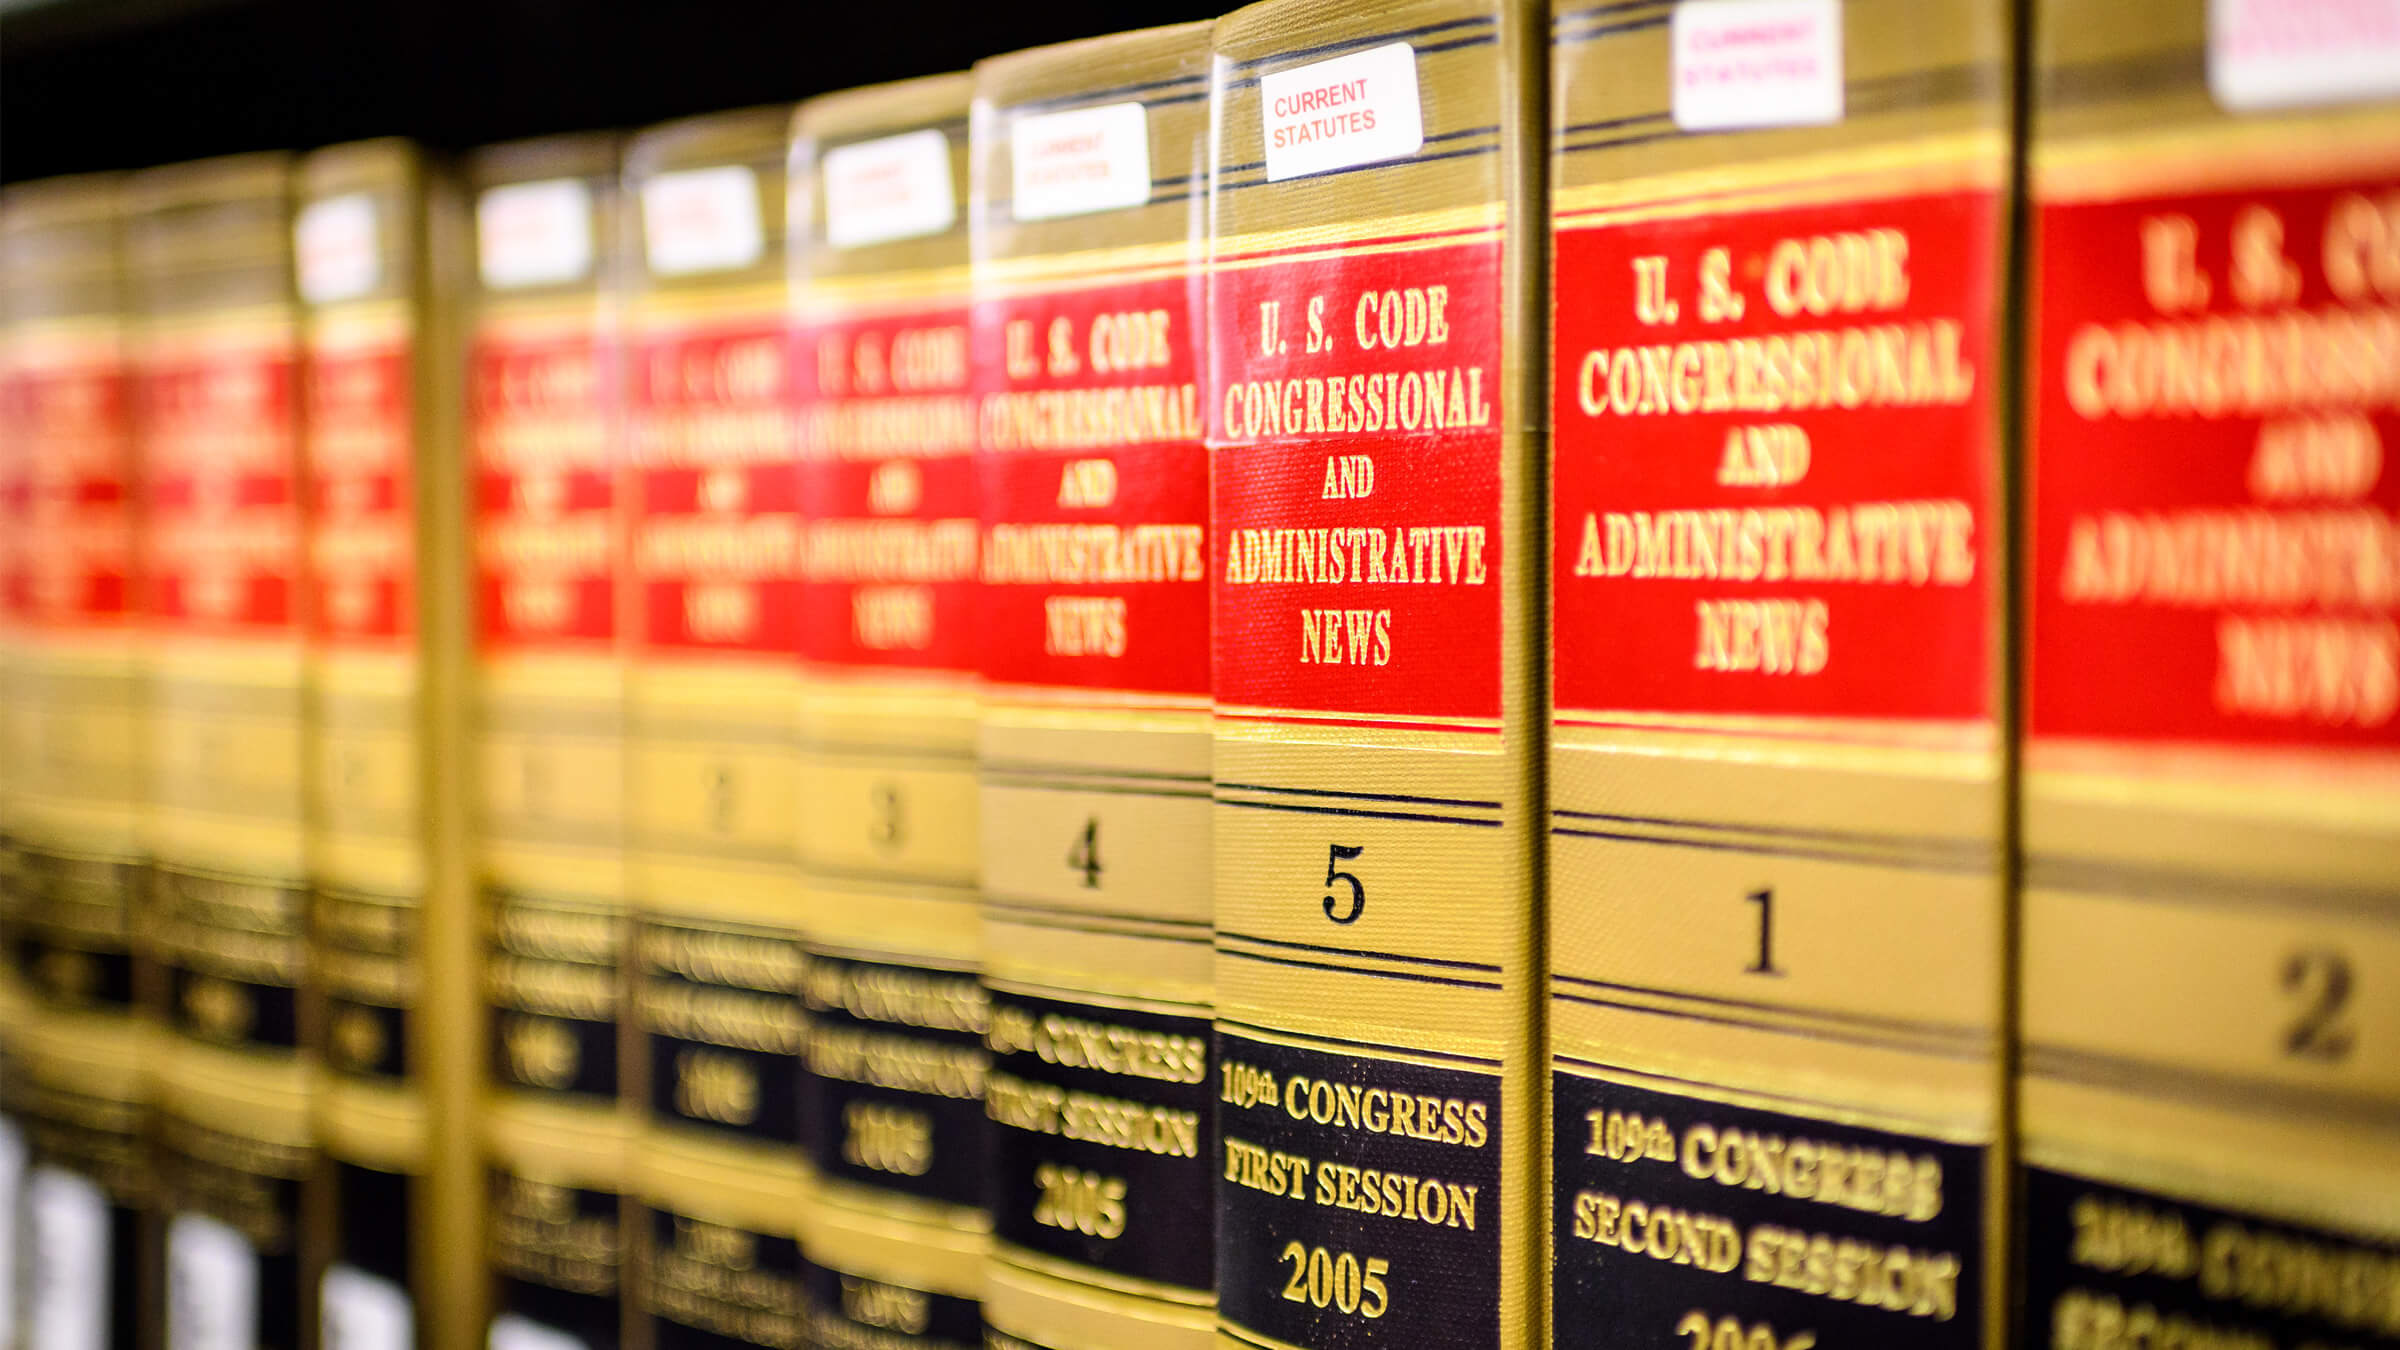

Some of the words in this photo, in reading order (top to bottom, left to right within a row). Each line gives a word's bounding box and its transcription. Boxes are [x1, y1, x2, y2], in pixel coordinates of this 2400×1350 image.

[1273, 109, 1376, 149] STATUTES
[1274, 79, 1368, 118] CURRENT
[1632, 256, 1679, 325] U.
[1697, 246, 1745, 322] S.
[1765, 228, 1910, 317] CODE
[1260, 301, 1286, 356] U.
[1306, 295, 1333, 353] S.
[1355, 285, 1449, 350] CODE
[1223, 366, 1490, 439] CONGRESSIONAL
[1578, 318, 1975, 416] CONGRESSIONAL
[1056, 459, 1118, 509] AND
[1321, 455, 1374, 499] AND
[1716, 424, 1811, 487] AND
[1224, 526, 1487, 584] ADMINISTRATIVE
[1574, 498, 1976, 588] ADMINISTRATIVE
[1044, 595, 1128, 658] NEWS
[1300, 609, 1391, 666] NEWS
[1694, 597, 1829, 675] NEWS
[1067, 817, 1105, 889] 4
[1322, 844, 1365, 926] 5
[1743, 888, 1787, 978] 1
[2279, 947, 2358, 1065] 2
[1220, 1062, 1279, 1110] 109th
[1285, 1076, 1488, 1148] CONGRESS
[1034, 1164, 1128, 1240] 2005
[1223, 1136, 1310, 1200] FIRST
[1316, 1162, 1478, 1231] SESSION
[1584, 1108, 1677, 1164] 109th
[1679, 1124, 1943, 1222] CONGRESS
[1281, 1241, 1389, 1319] 2005
[1572, 1190, 1742, 1273] SECOND
[1744, 1224, 1961, 1323] SESSION
